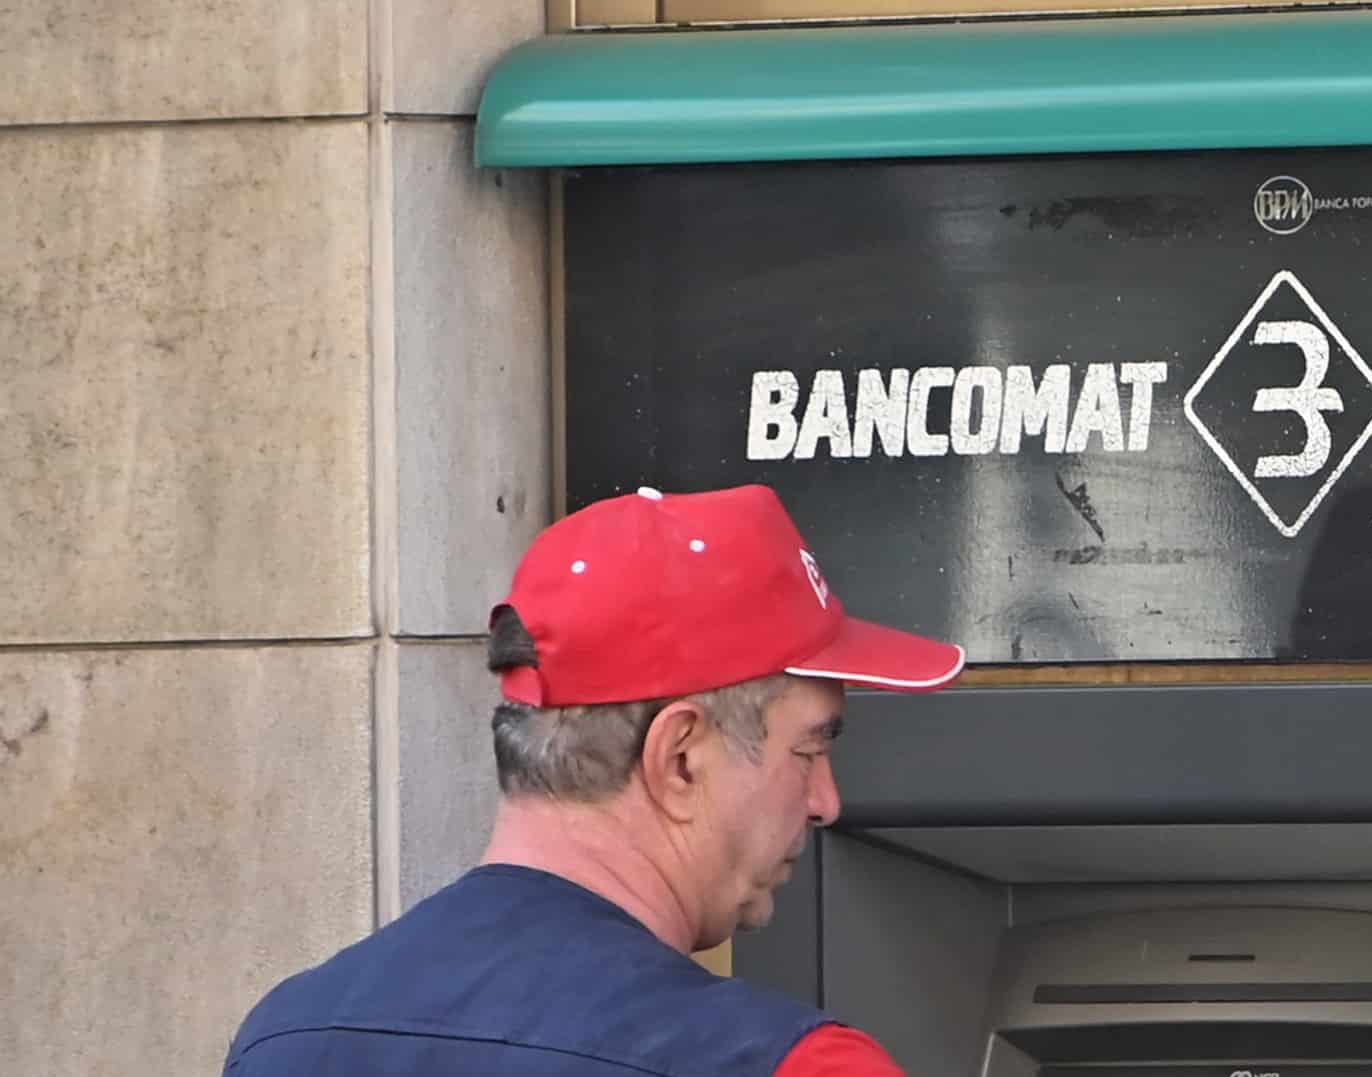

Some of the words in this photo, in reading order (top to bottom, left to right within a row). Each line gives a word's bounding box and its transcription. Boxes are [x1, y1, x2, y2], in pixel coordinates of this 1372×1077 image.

[1257, 189, 1309, 221] BPM
[1314, 197, 1349, 209] BANCA
[747, 361, 1168, 461] BANCOMAT
